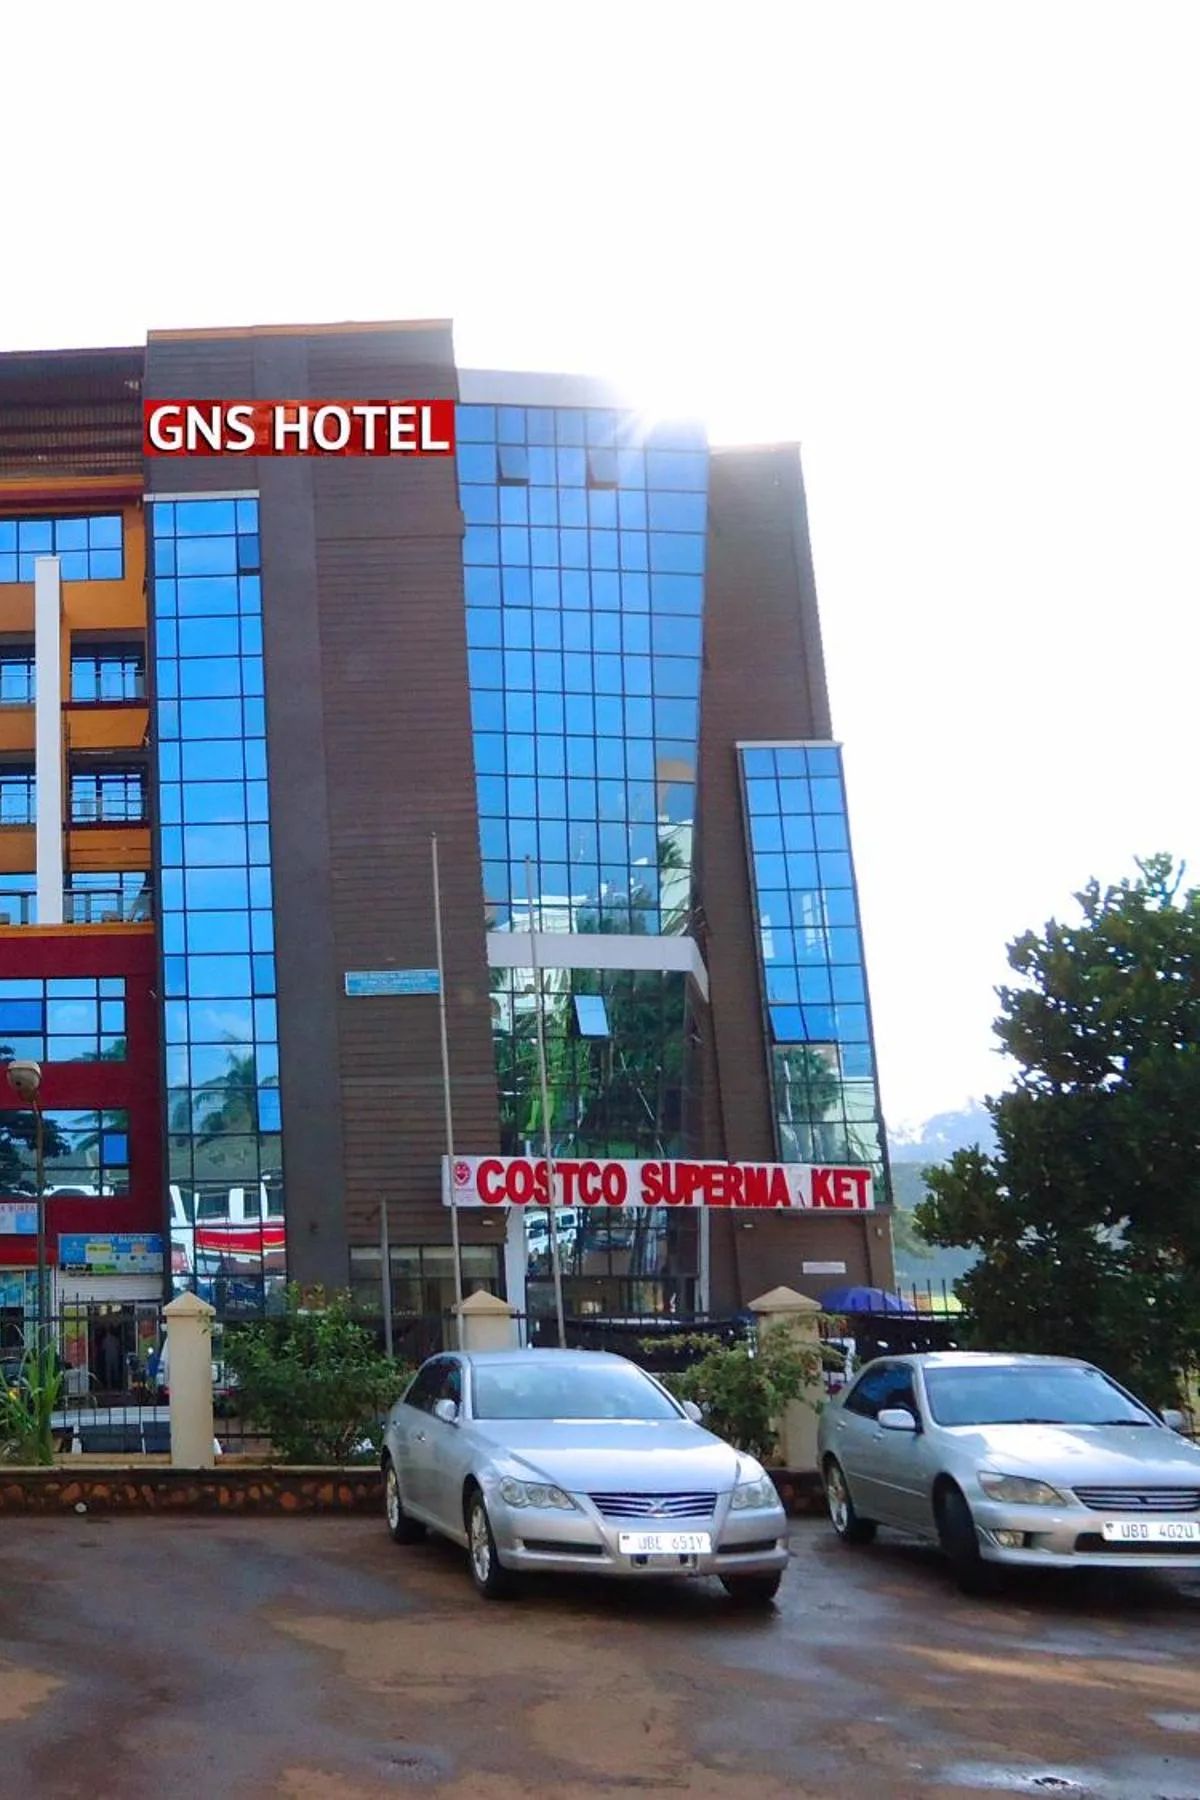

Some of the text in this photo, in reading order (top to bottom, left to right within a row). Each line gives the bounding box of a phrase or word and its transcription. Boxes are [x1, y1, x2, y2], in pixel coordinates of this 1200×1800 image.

[149, 405, 450, 451] GNS HOTEL
[476, 1159, 872, 1209] COSTCO SUPERMAKET
